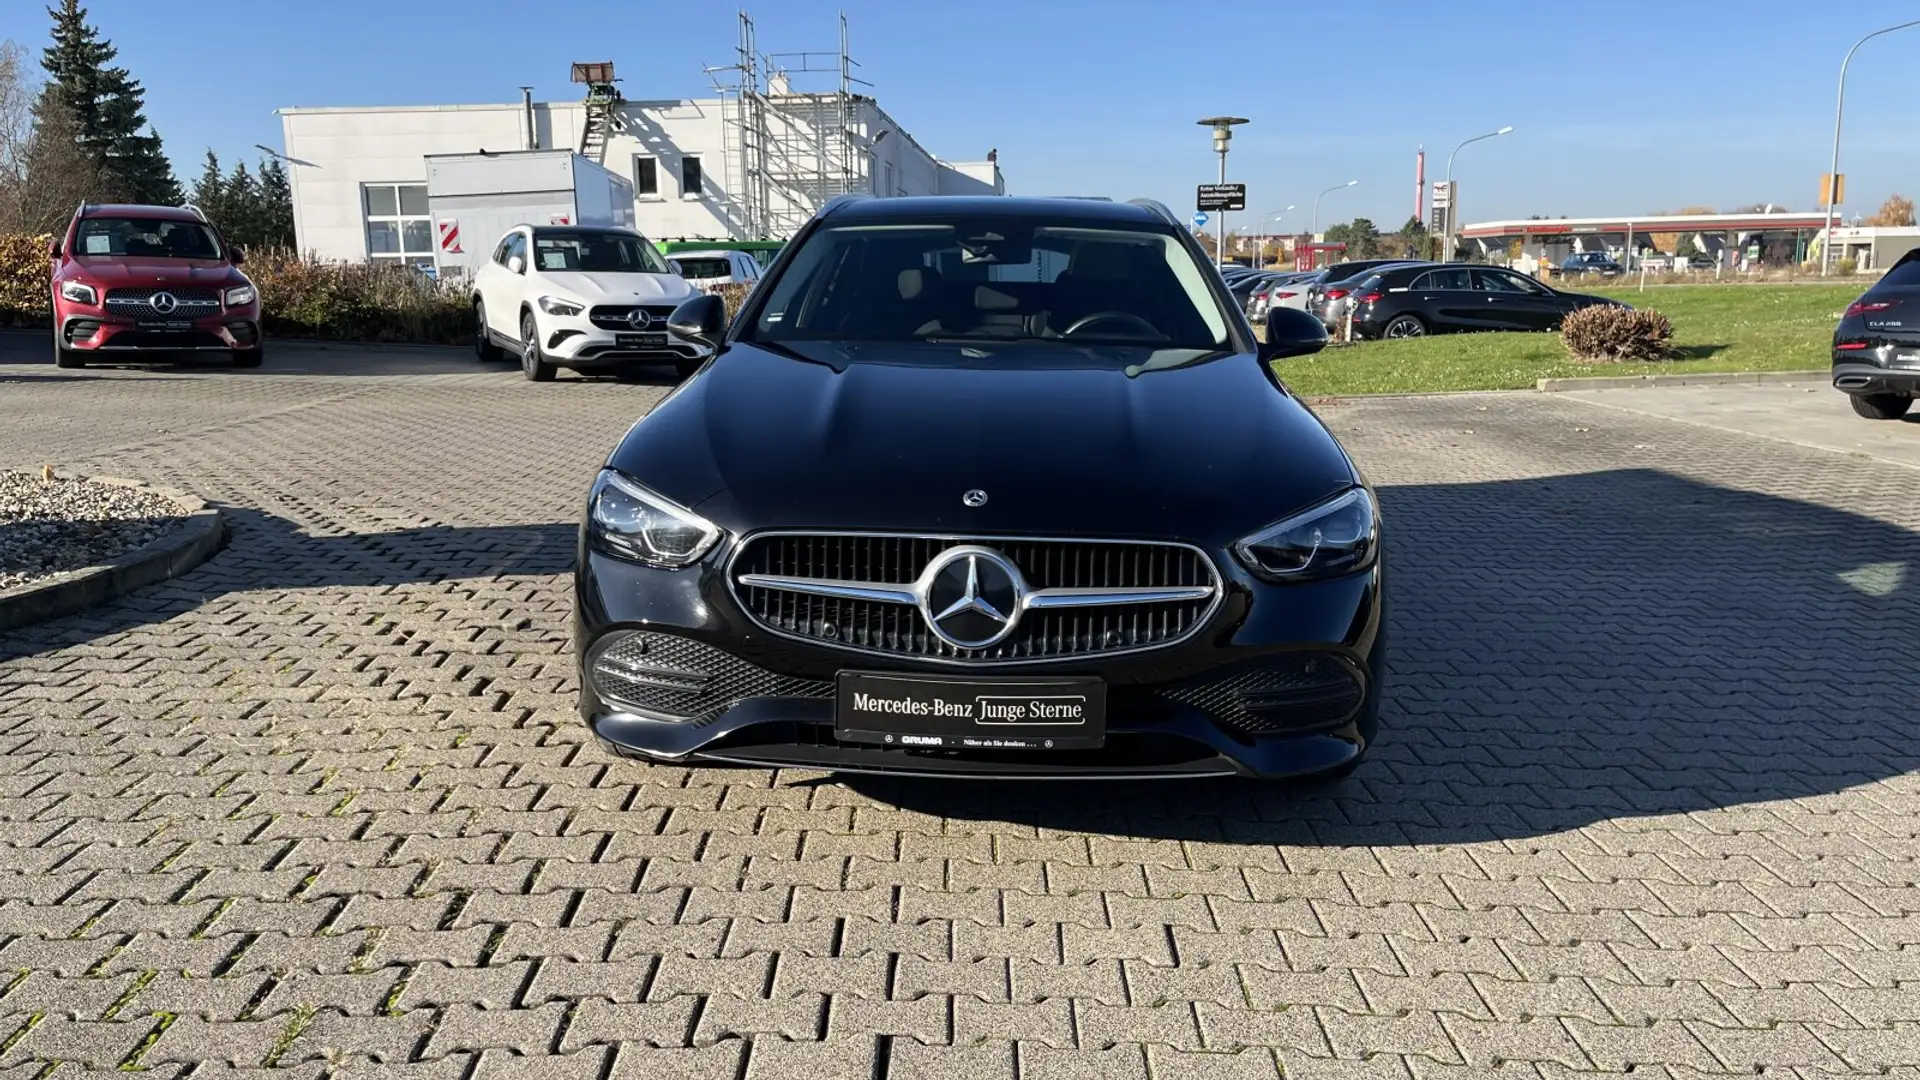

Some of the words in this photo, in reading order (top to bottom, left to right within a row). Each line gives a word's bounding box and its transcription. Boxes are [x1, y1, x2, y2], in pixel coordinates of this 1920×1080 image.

[853, 692, 973, 718] Mercedes-Benz
[980, 700, 1026, 722] Junge
[1029, 700, 1082, 718] Sterne
[901, 735, 942, 745] GRUMA
